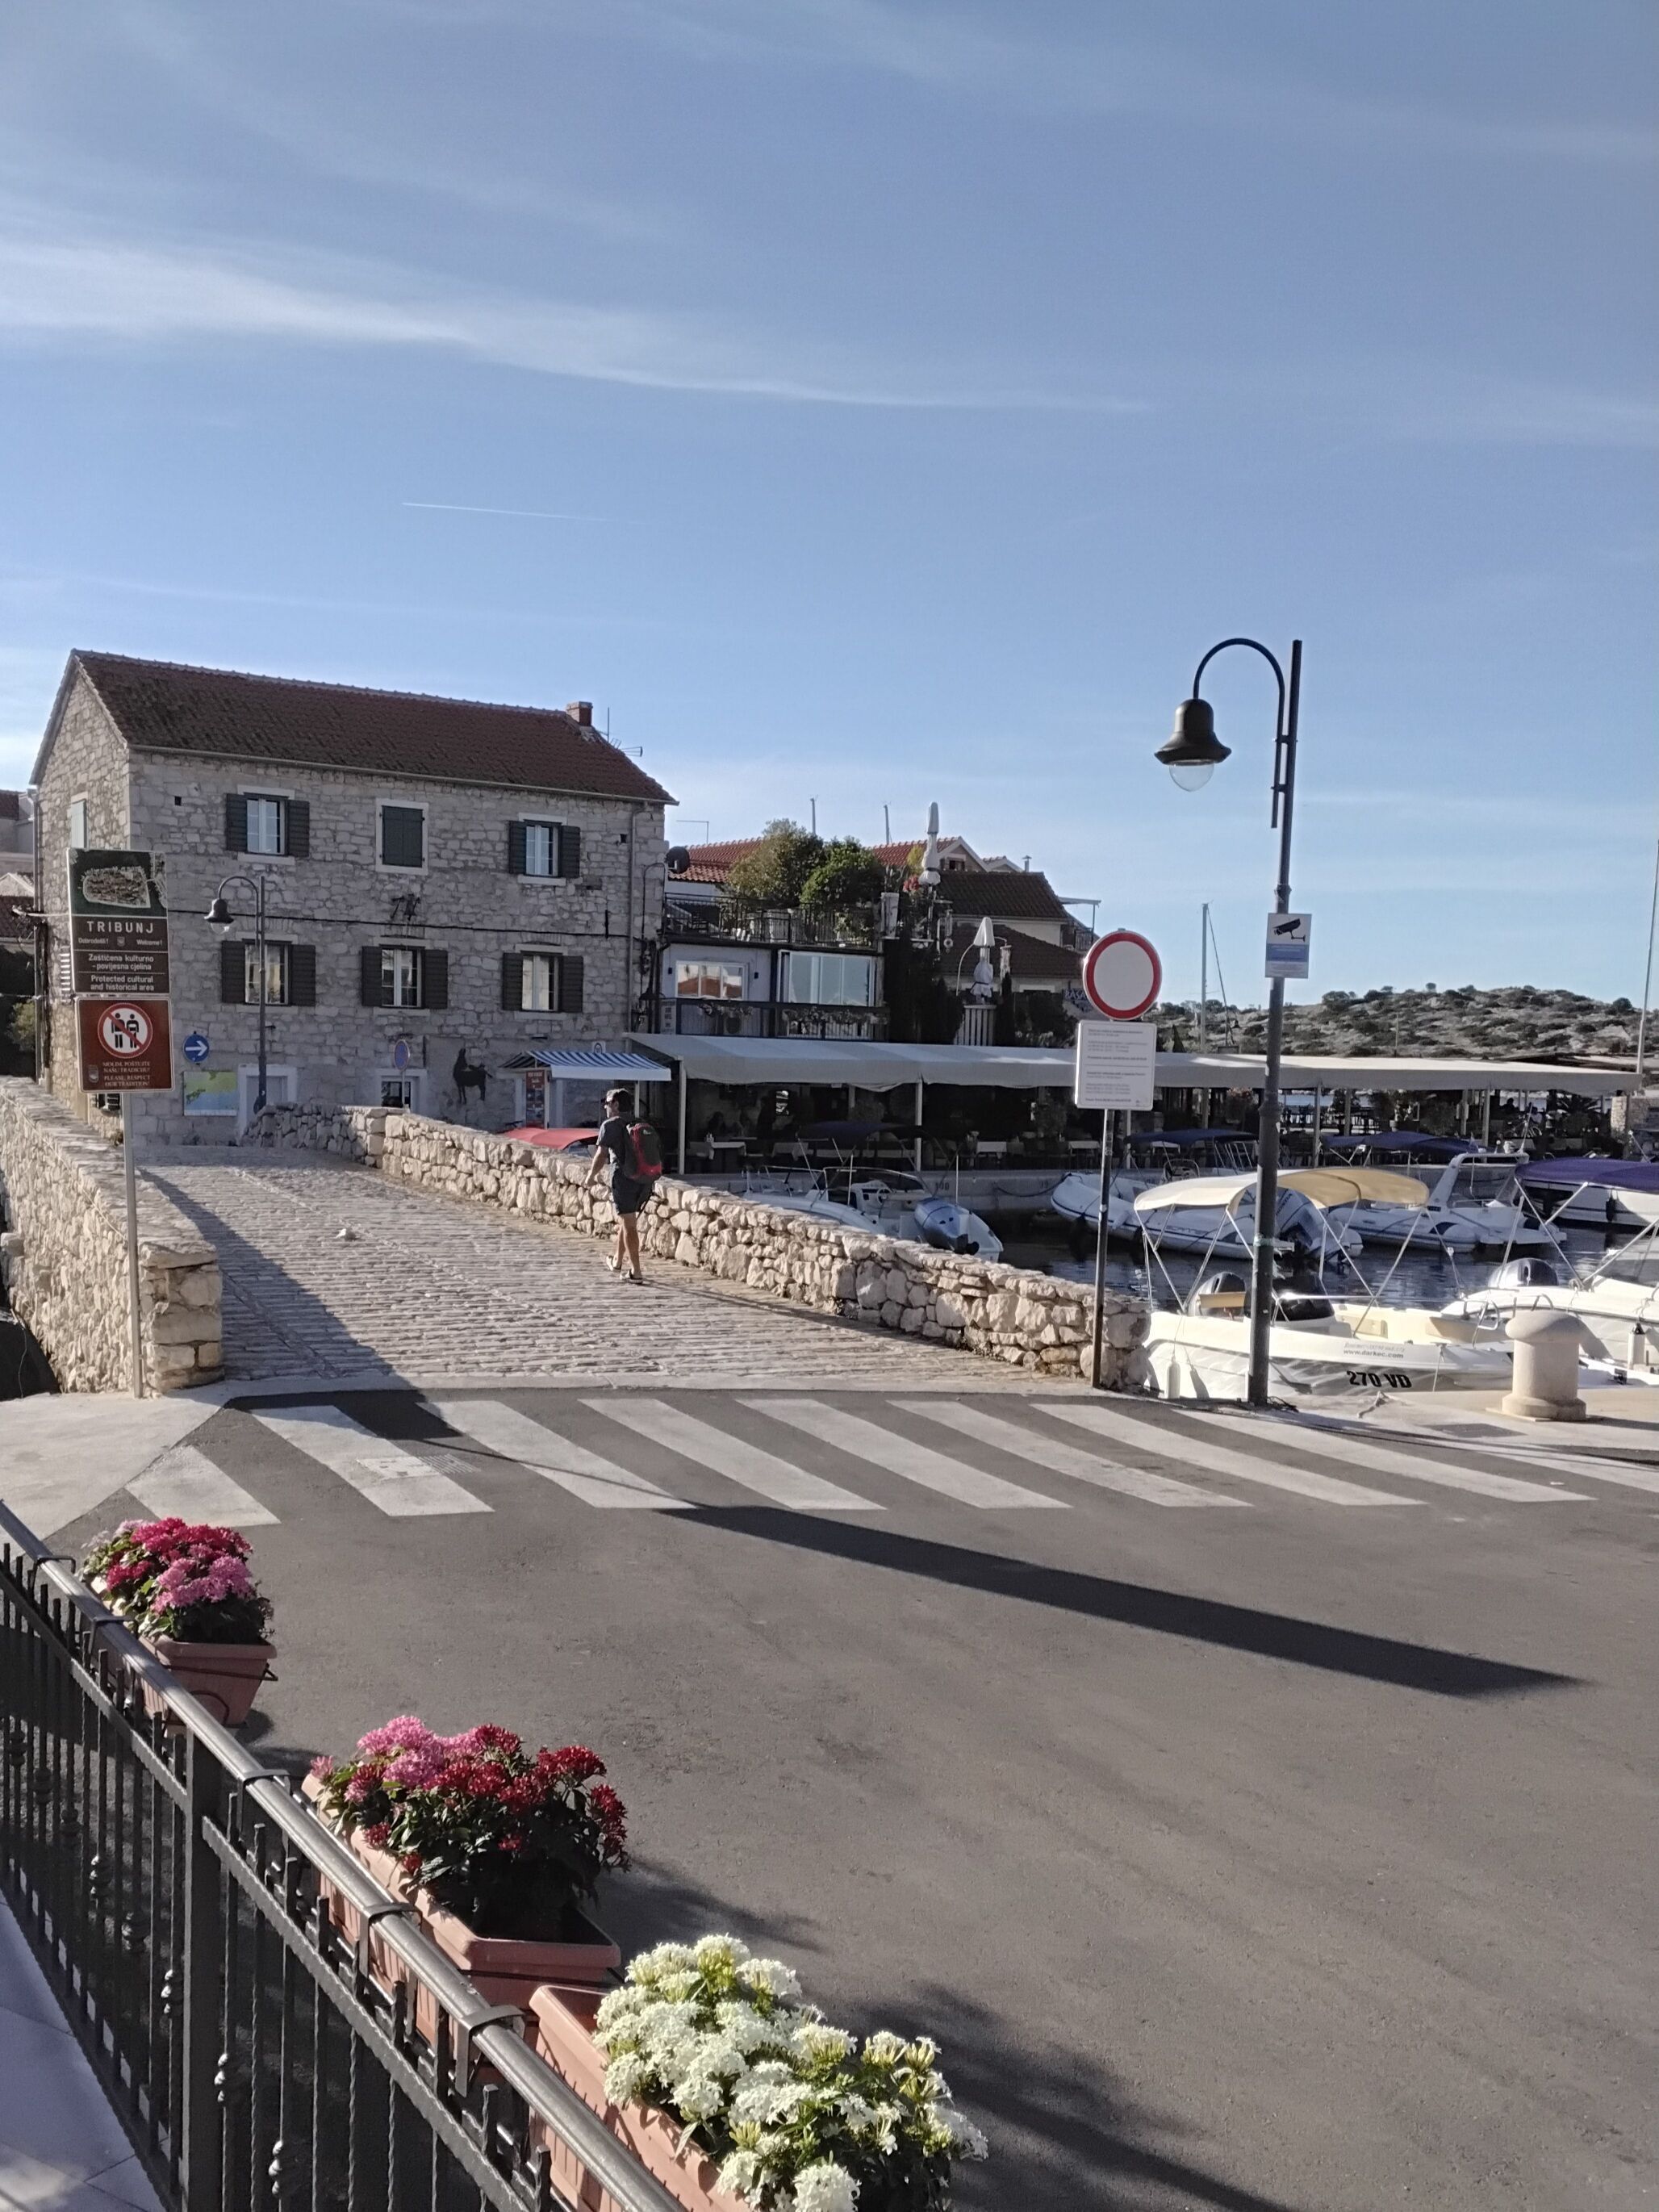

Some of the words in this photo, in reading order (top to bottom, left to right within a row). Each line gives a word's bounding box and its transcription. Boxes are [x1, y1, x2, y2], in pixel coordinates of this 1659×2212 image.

[87, 921, 153, 933] TRIBUNJ
[88, 953, 123, 962] Zaštićena
[90, 975, 126, 983] Protected
[1346, 1369, 1382, 1387] 270
[1383, 1374, 1412, 1388] VD
